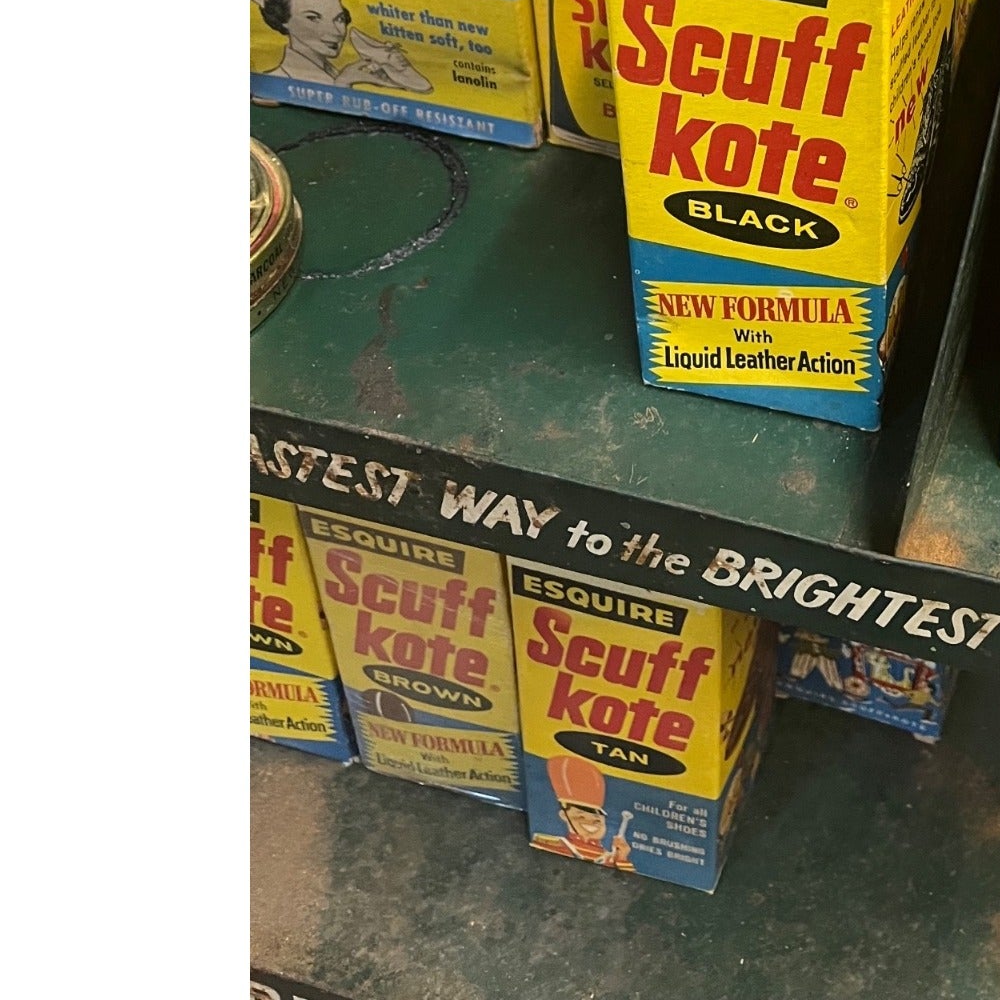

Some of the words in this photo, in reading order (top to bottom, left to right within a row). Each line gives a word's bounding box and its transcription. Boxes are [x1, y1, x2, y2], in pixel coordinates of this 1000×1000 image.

[367, 2, 415, 22] whiter
[420, 10, 454, 29] than
[458, 20, 488, 36] new
[380, 22, 424, 43] kitten
[430, 32, 464, 52] soft,
[468, 40, 492, 56] too
[452, 70, 498, 90] lanolin
[453, 58, 496, 74] contains
[288, 85, 334, 104] SUPER
[416, 106, 495, 134] RESISTANT
[894, 60, 930, 144] new
[649, 91, 847, 205] kote
[688, 199, 819, 240] BLACK
[657, 293, 715, 319] NEW
[721, 295, 854, 324] FORMULA
[733, 328, 773, 344] With
[664, 345, 721, 370] Liquid
[726, 346, 796, 371] Leather
[797, 351, 856, 375] Action
[310, 518, 456, 569] ESQUIRE
[440, 479, 562, 539] WAY
[567, 520, 612, 556] to
[621, 532, 691, 575] the
[324, 547, 497, 639] Scuff
[523, 574, 675, 628] ESQUIRE
[354, 609, 489, 689] kote
[526, 606, 716, 701] Scuff
[373, 669, 482, 708] BROWN
[250, 715, 285, 729] eather
[286, 716, 327, 732] Action
[547, 671, 695, 752] kote
[412, 733, 505, 756] FORMULA
[591, 741, 649, 766] TAN
[469, 769, 511, 783] Action
[634, 802, 707, 827] CHILDREN'S
[669, 800, 688, 812] For
[693, 808, 707, 817] all
[666, 821, 707, 838] SHOES
